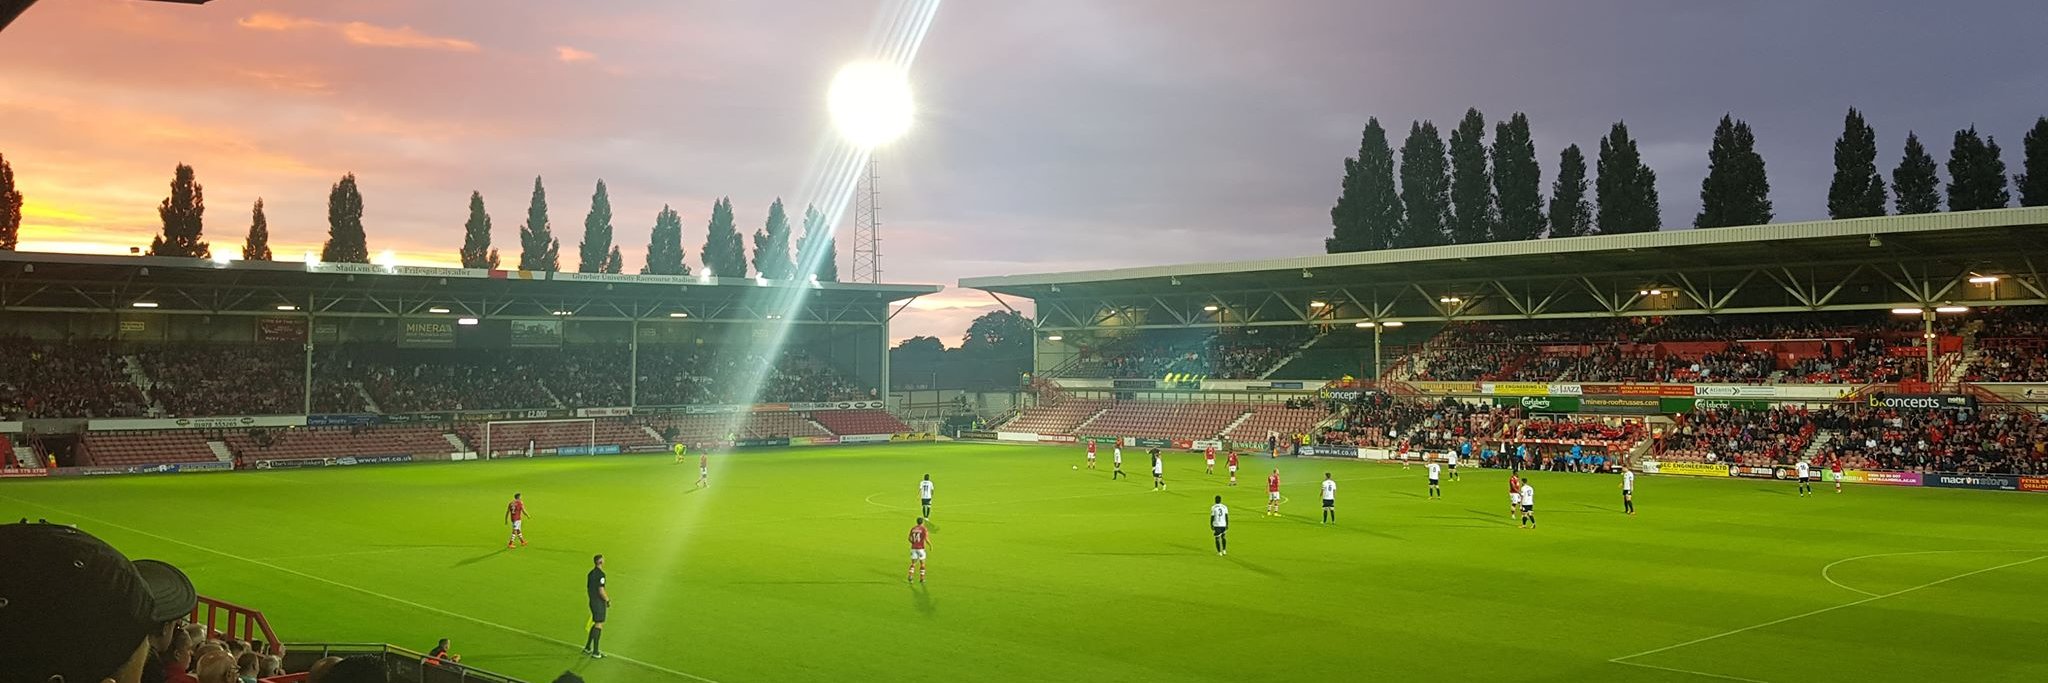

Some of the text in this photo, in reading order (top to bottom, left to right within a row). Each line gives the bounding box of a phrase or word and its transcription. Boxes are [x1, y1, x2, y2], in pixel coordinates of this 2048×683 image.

[1695, 386, 1710, 395] UK
[1521, 396, 1551, 408] Carlsberg
[1217, 507, 1223, 517] 3
